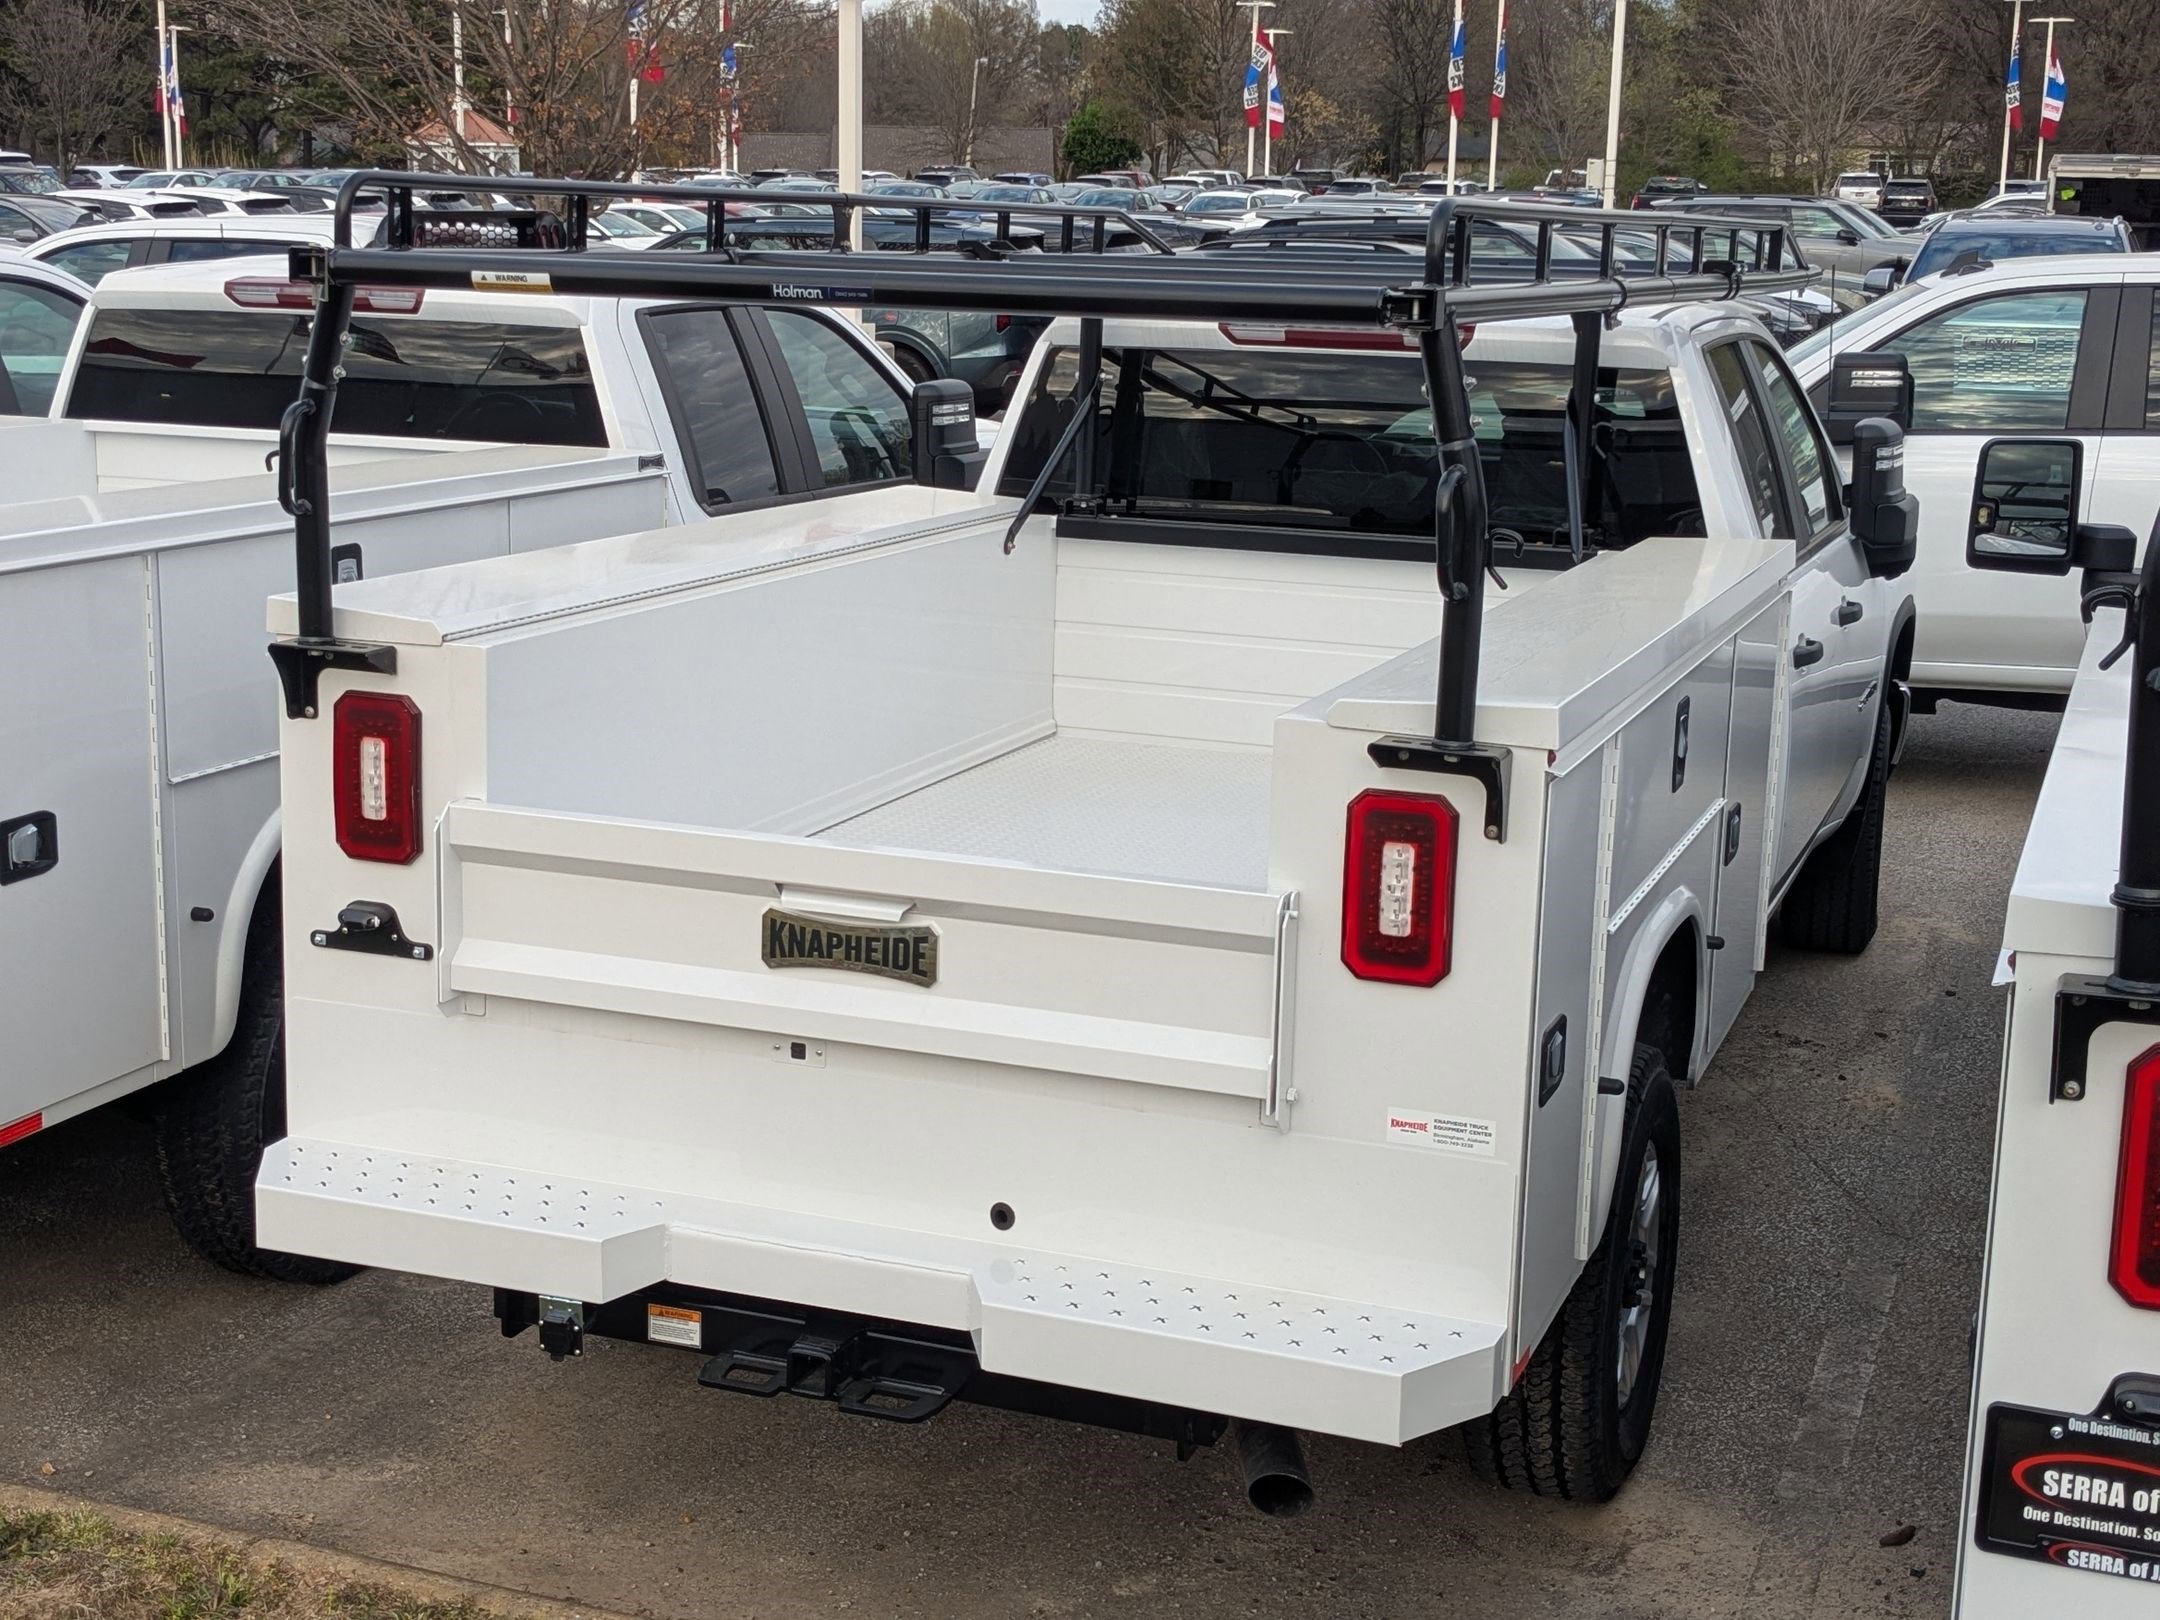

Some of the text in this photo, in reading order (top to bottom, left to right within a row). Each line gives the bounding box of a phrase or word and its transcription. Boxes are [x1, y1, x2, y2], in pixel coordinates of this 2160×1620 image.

[495, 274, 528, 283] WARNING
[772, 283, 824, 299] Holman
[769, 917, 929, 978] KNAPHEIDE
[1390, 1118, 1428, 1133] KNAPHEIDE
[1433, 1119, 1489, 1131] KNAPHEIDE TRUCK
[1433, 1125, 1492, 1138] EQUIPMENT CENTER
[2068, 1417, 2088, 1433] One
[2090, 1421, 2151, 1444] Destination.
[2043, 1470, 2160, 1514] SERRA of
[2023, 1506, 2050, 1523] One
[2054, 1511, 2141, 1539] Destination.
[2067, 1549, 2160, 1582] SERRA of J
